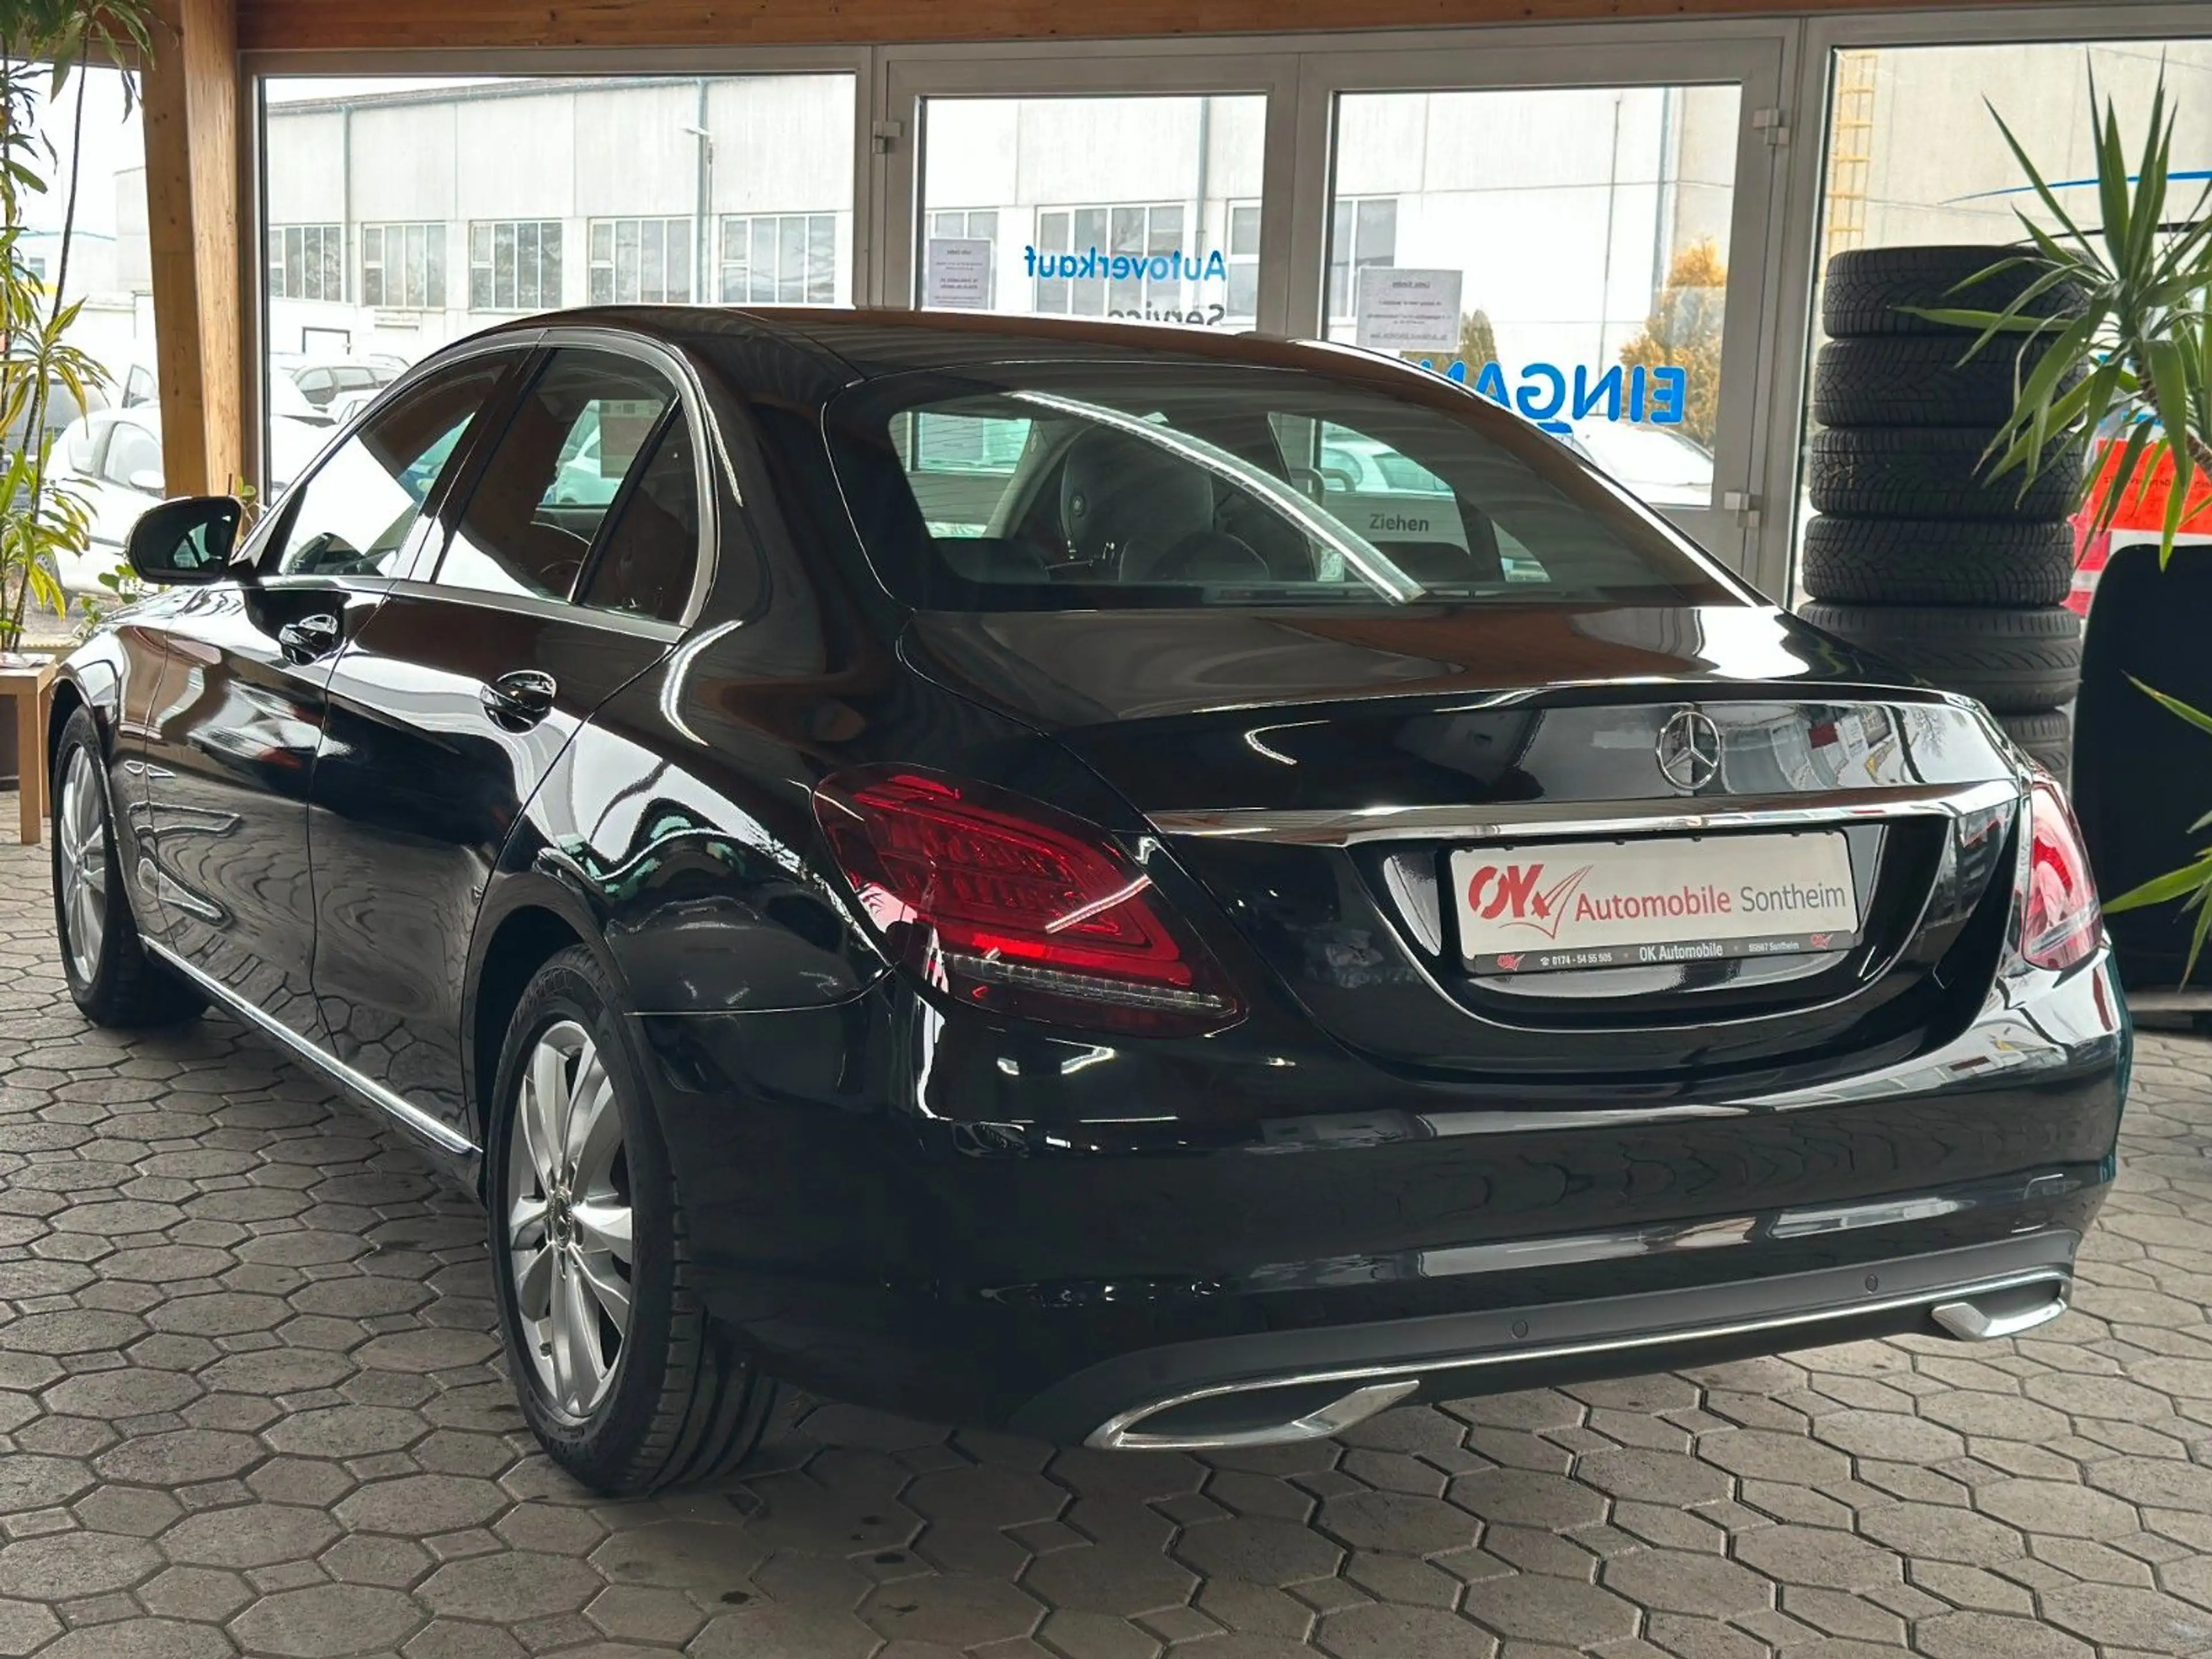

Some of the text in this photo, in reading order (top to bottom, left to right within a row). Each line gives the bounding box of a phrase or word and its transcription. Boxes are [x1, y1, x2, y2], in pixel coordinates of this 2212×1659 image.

[1369, 513, 1430, 532] Ziehen
[1468, 863, 1846, 922] OK Automobile Sontheim
[1639, 943, 1724, 961] OK Automobile
